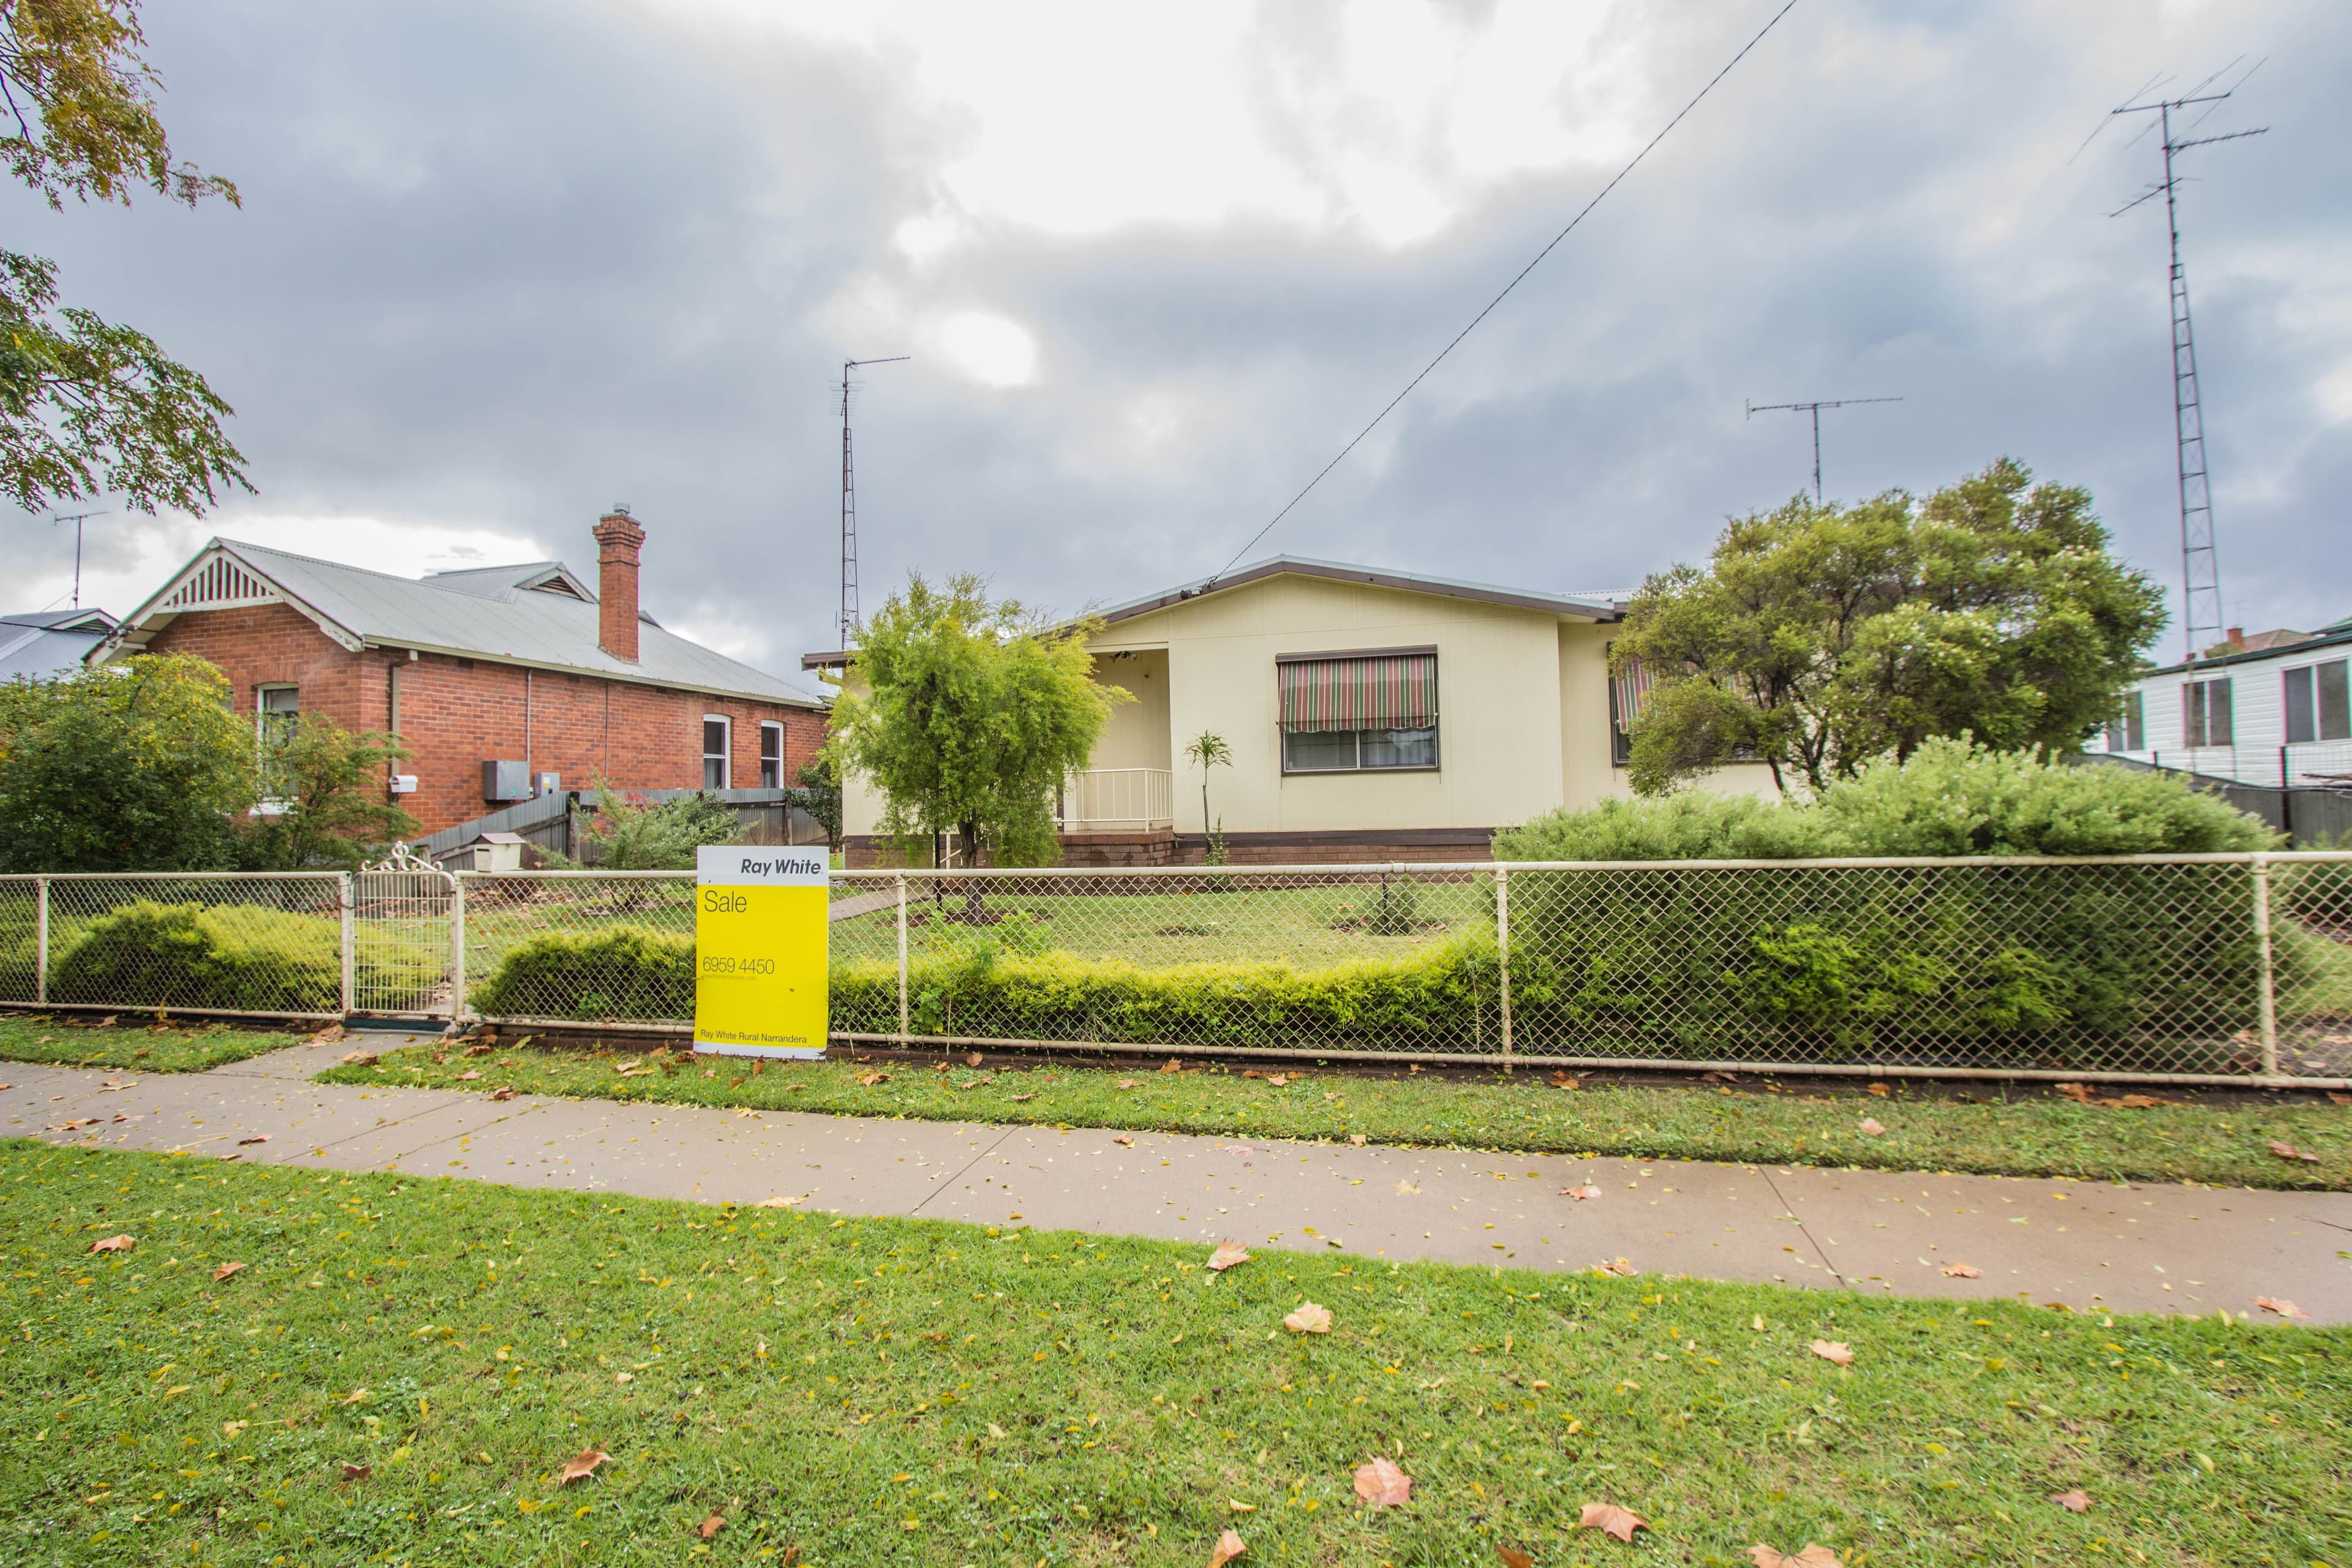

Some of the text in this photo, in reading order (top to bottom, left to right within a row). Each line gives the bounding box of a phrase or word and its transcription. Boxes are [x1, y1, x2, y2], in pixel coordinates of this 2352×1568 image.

[741, 858, 821, 876] Ray White
[704, 890, 747, 913] Sale
[703, 956, 775, 974] 6959 4450
[701, 1029, 807, 1043] Ray White Rural Narrandera
